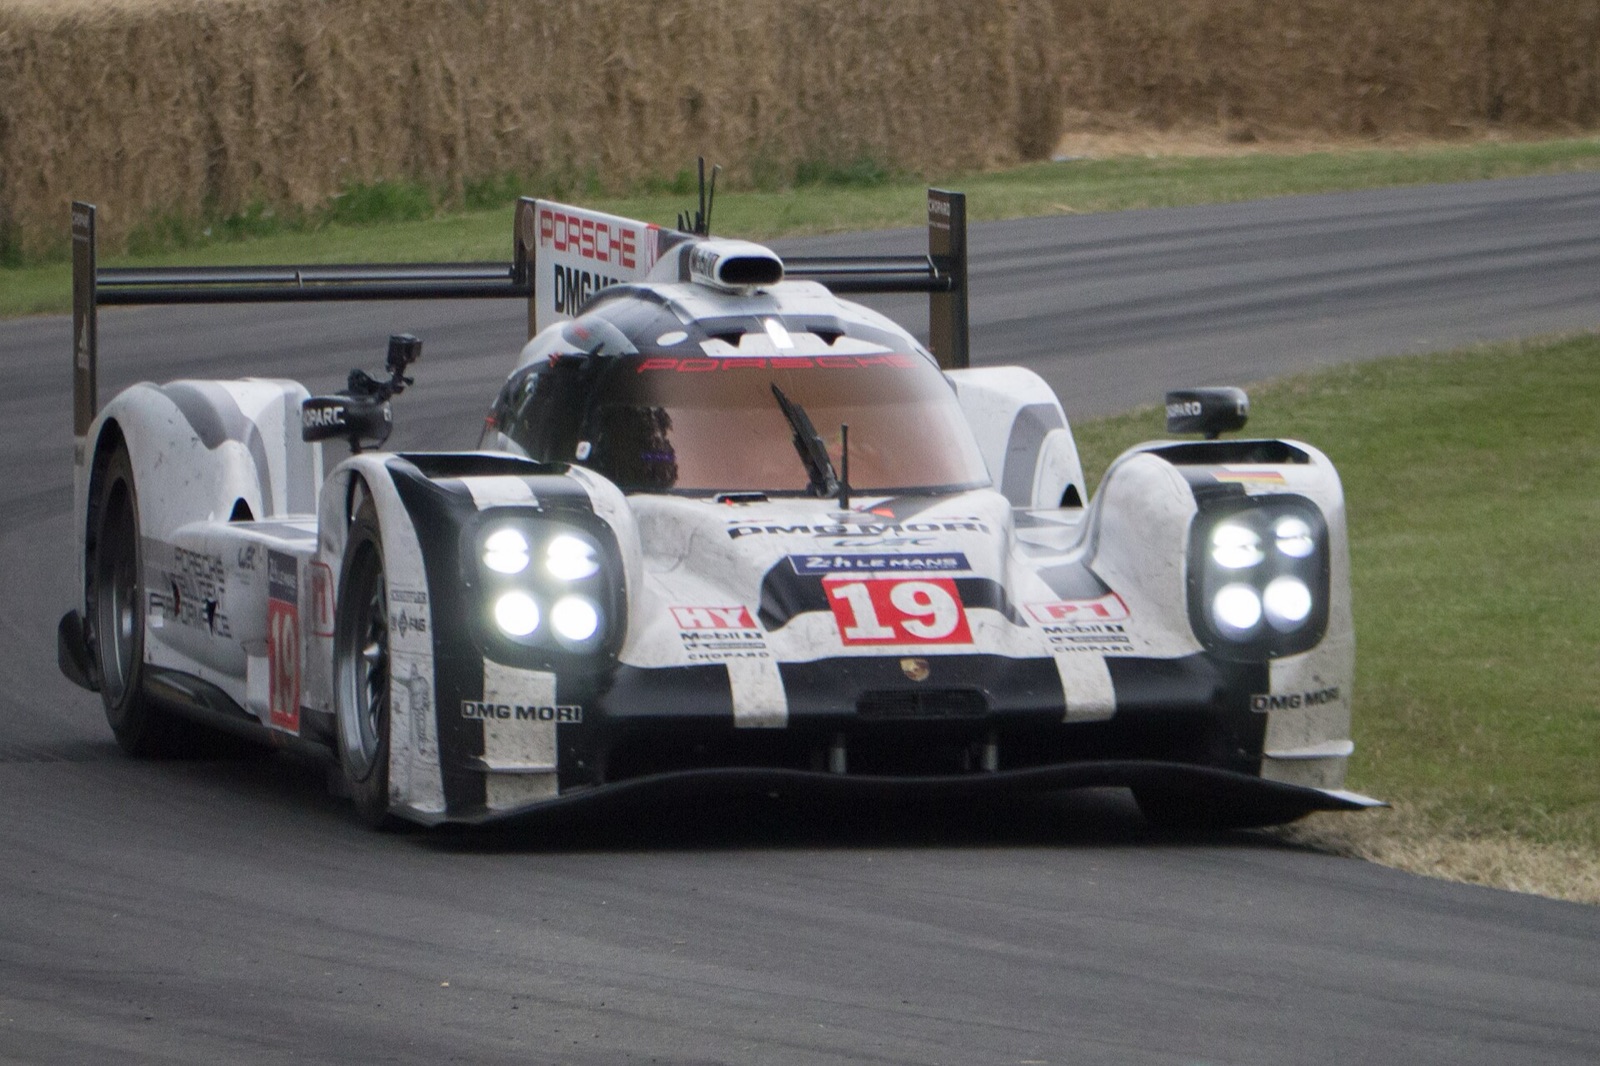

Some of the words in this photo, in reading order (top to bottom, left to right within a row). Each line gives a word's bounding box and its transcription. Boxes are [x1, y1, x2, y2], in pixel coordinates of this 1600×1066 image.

[540, 210, 636, 269] PORSCHE
[636, 357, 917, 373] PORSCHE
[859, 522, 991, 536] MORI
[857, 558, 886, 568] LE
[889, 558, 958, 570] MANS
[671, 607, 745, 629] HY
[831, 581, 960, 640] 19
[1044, 603, 1111, 619] P1
[680, 632, 741, 641] Mobil
[1042, 625, 1102, 634] Mobil
[688, 651, 770, 660] CHOPARD
[1053, 644, 1135, 653] CHOPARD
[1254, 694, 1301, 711] DMG
[462, 702, 511, 720] DMG
[515, 705, 581, 722] MORI
